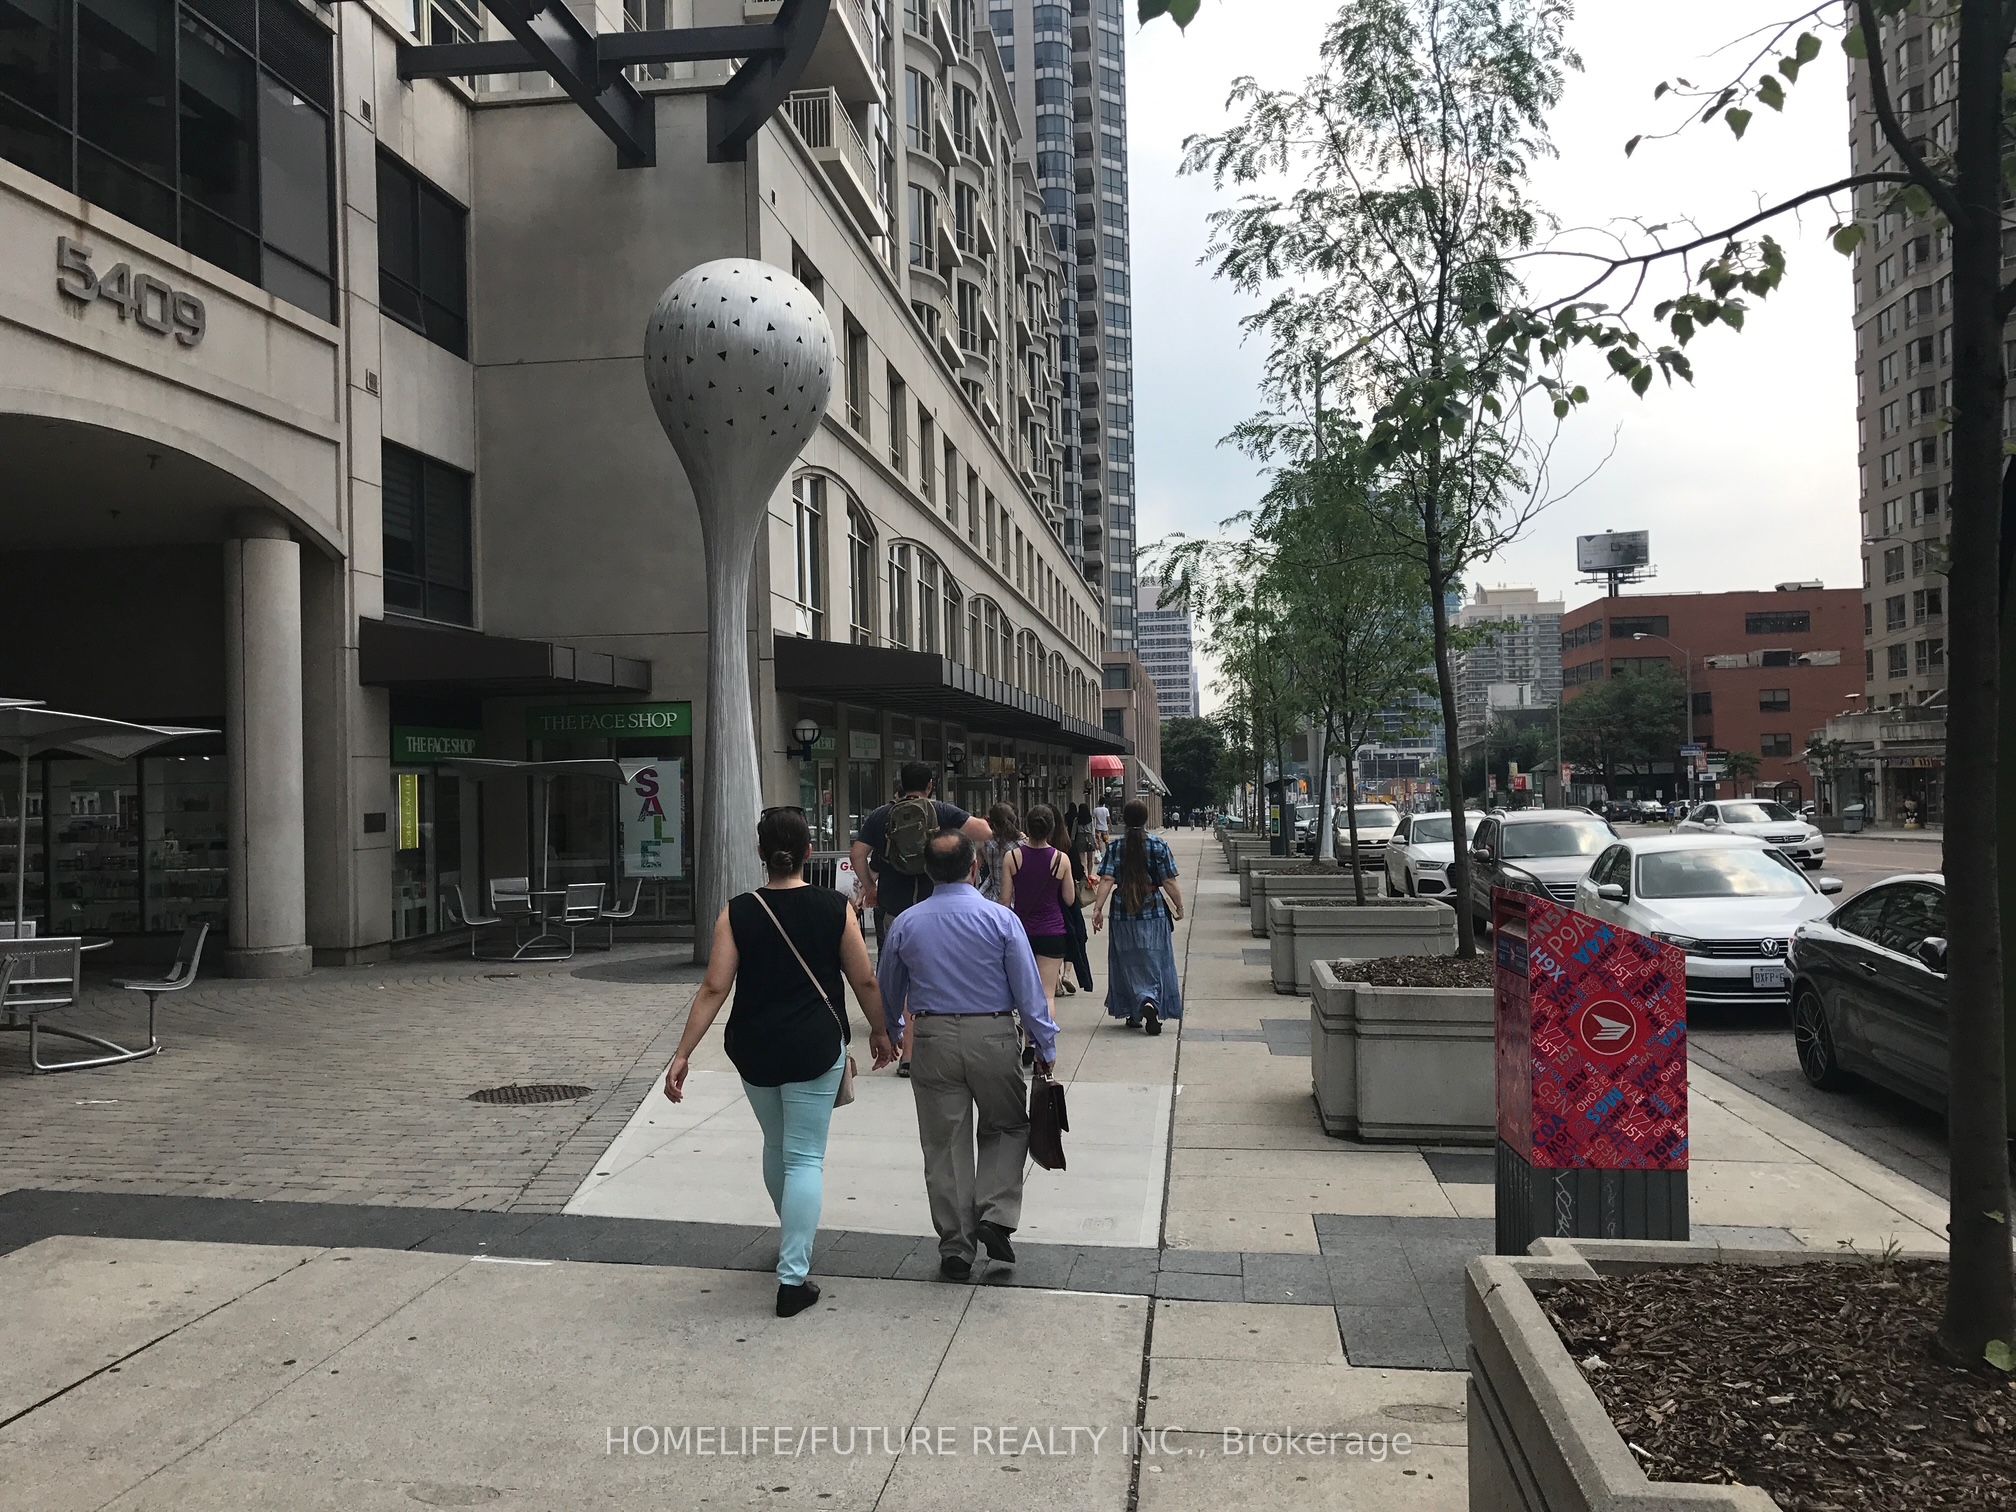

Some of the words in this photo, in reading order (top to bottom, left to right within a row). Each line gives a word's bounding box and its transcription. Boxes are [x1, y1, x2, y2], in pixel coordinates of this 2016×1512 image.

[57, 236, 206, 346] 5409
[542, 714, 577, 731] THE
[580, 713, 625, 730] FACE
[628, 712, 678, 729] SHOP
[406, 736, 427, 753] THE
[427, 737, 451, 754] FACE
[451, 737, 476, 754] SHOP
[636, 768, 675, 869] SALE
[1548, 915, 1594, 958] P9A
[1572, 925, 1615, 965] K4A
[1530, 946, 1567, 982] H9X
[1613, 963, 1632, 981] J5T
[1617, 945, 1642, 974] V7J
[1530, 991, 1552, 1015] X1A
[1645, 992, 1660, 1009] A1B
[1654, 1003, 1675, 1026] P9A
[1537, 1038, 1560, 1056] J5T
[1544, 1020, 1570, 1049] V7J
[1538, 1082, 1573, 1115] G3N
[1586, 1077, 1605, 1096] P9A
[1615, 1076, 1638, 1101] X1A
[1585, 1086, 1624, 1126] M6S
[1628, 1104, 1655, 1134] V7J
[1621, 1123, 1644, 1142] J5T
